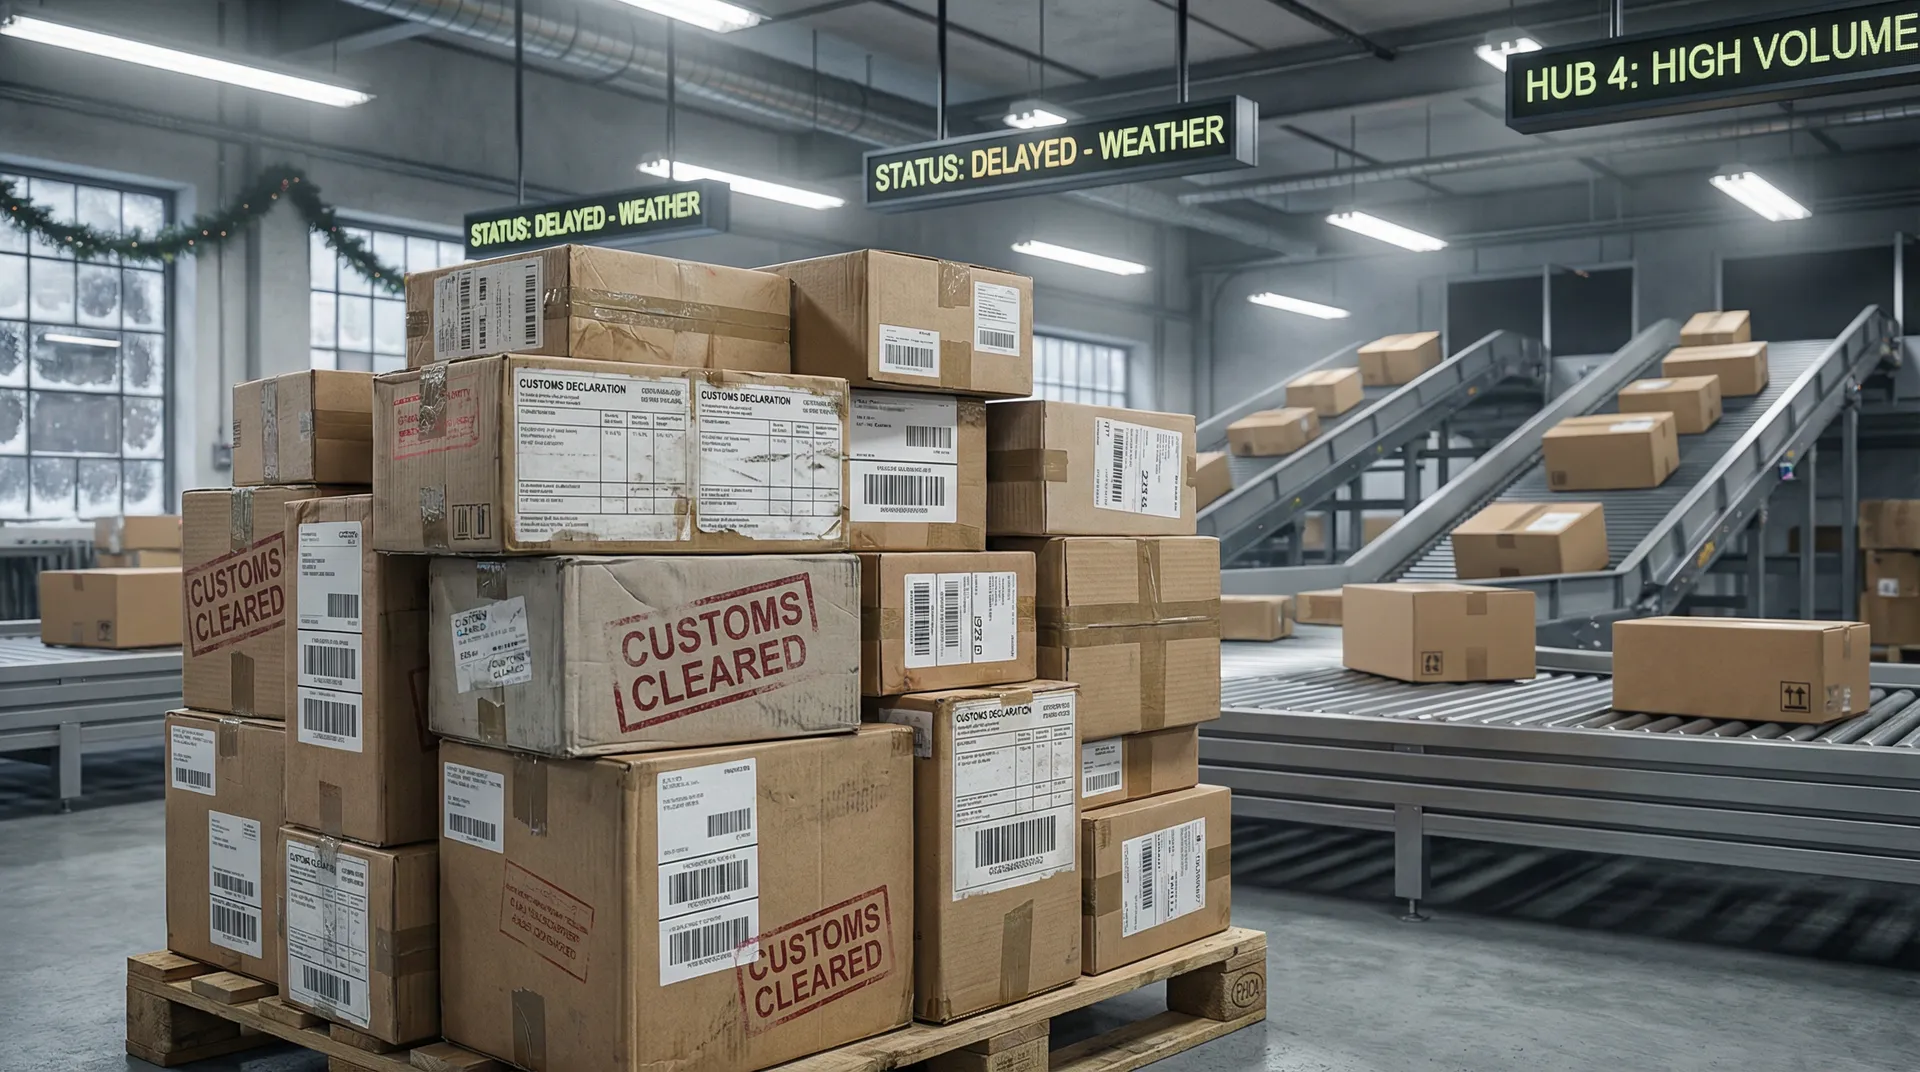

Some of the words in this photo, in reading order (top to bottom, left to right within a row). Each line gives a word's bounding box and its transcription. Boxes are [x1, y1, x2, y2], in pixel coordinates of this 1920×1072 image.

[1526, 60, 1597, 103] HUB
[1607, 56, 1638, 90] 4:
[1652, 39, 1741, 85] HIGH
[1753, 12, 1919, 70] VOLUME
[875, 153, 964, 192] STATUS:
[971, 136, 1077, 179] DELAYED
[1099, 115, 1225, 160] WEATHER
[470, 216, 532, 247] STATUS:
[534, 205, 606, 238] DELAYED
[618, 190, 701, 226] WEATHER
[519, 378, 564, 391] CUSTOMS
[566, 382, 627, 395] DECLARATION
[701, 390, 739, 402] CUSTOMS
[741, 393, 791, 405] DECLARATION
[191, 547, 282, 607] CUSTOMS
[196, 585, 285, 641] CLEARED
[621, 591, 803, 667] CUSTOMS
[632, 634, 807, 712] CLEARED
[749, 902, 881, 981] CUSTOMS
[755, 939, 882, 1018] CLEARED
